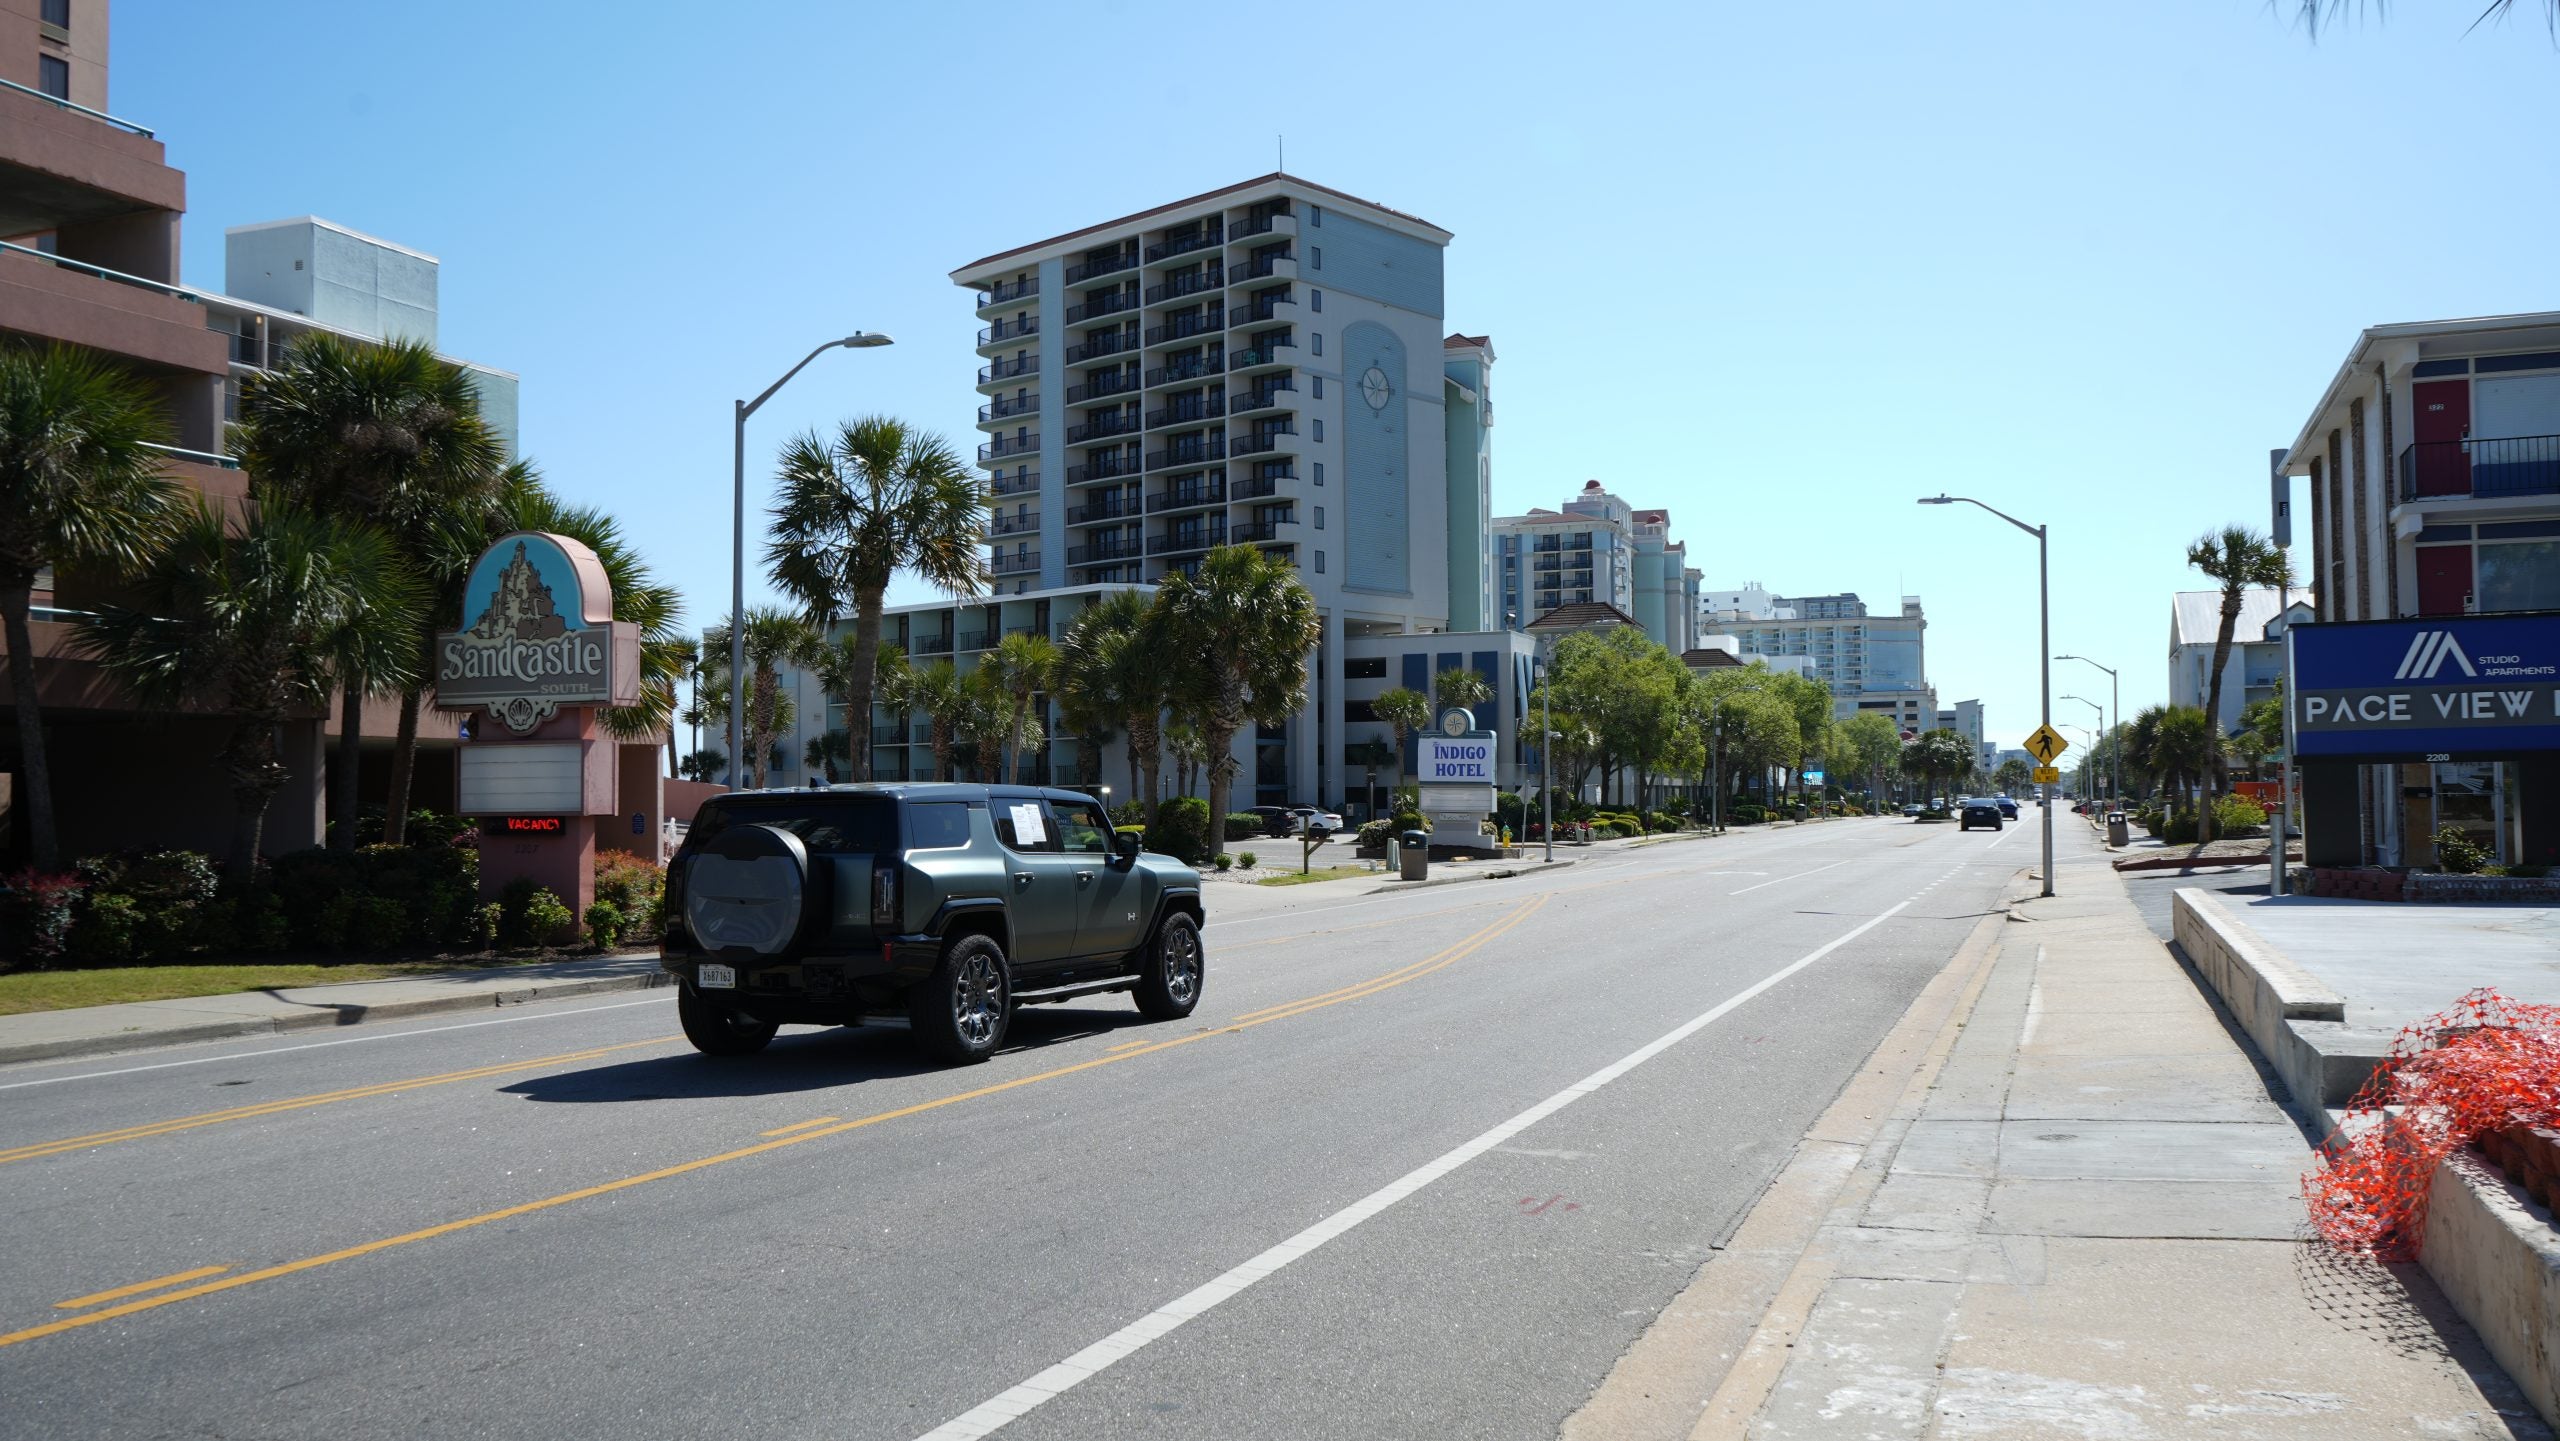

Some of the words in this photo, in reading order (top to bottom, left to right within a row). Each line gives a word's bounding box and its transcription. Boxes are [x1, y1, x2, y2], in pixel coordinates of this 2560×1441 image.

[441, 637, 602, 682] Sandcastle
[2478, 655, 2520, 664] STUDIO
[2484, 666, 2556, 676] APARTMENTS
[540, 683, 589, 694] SOUTH
[2306, 694, 2411, 723] PACE
[2431, 691, 2533, 719] VIEW
[1434, 746, 1486, 759] INDIGO
[2426, 753, 2449, 762] 2200
[1435, 763, 1486, 777] HOTEL
